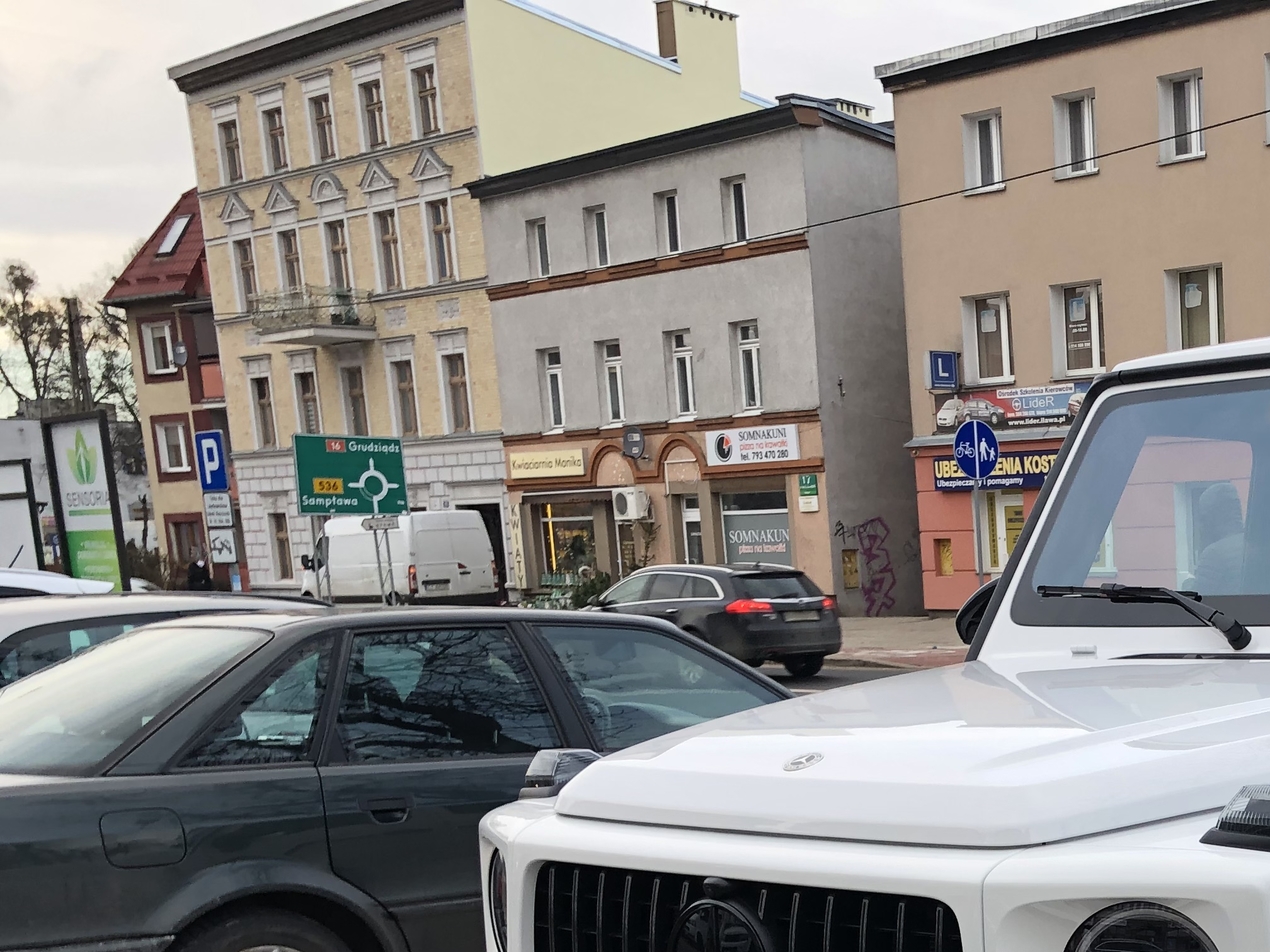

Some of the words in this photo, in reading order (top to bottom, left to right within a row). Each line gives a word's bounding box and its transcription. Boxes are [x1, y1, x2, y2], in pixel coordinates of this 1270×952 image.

[937, 358, 949, 377] L
[1020, 388, 1044, 396] Szkolenia
[1045, 385, 1073, 393] Kierowców
[1022, 396, 1055, 409] LideR
[738, 428, 787, 441] SOMNAKUNI
[330, 442, 341, 451] 16
[348, 441, 400, 455] Grudziądz
[201, 438, 220, 485] P
[740, 453, 750, 461] tel.
[752, 451, 763, 460] 793
[764, 450, 776, 459] 470
[777, 449, 789, 458] 280
[511, 457, 553, 471] Kwiaciarnia
[554, 455, 582, 468] Monika
[934, 457, 1023, 478] UBEZENIA
[318, 481, 339, 491] 536
[801, 476, 811, 484] 17
[987, 477, 1023, 486] pomagamy
[302, 495, 358, 507] Sampława
[510, 504, 524, 588] KWIATY
